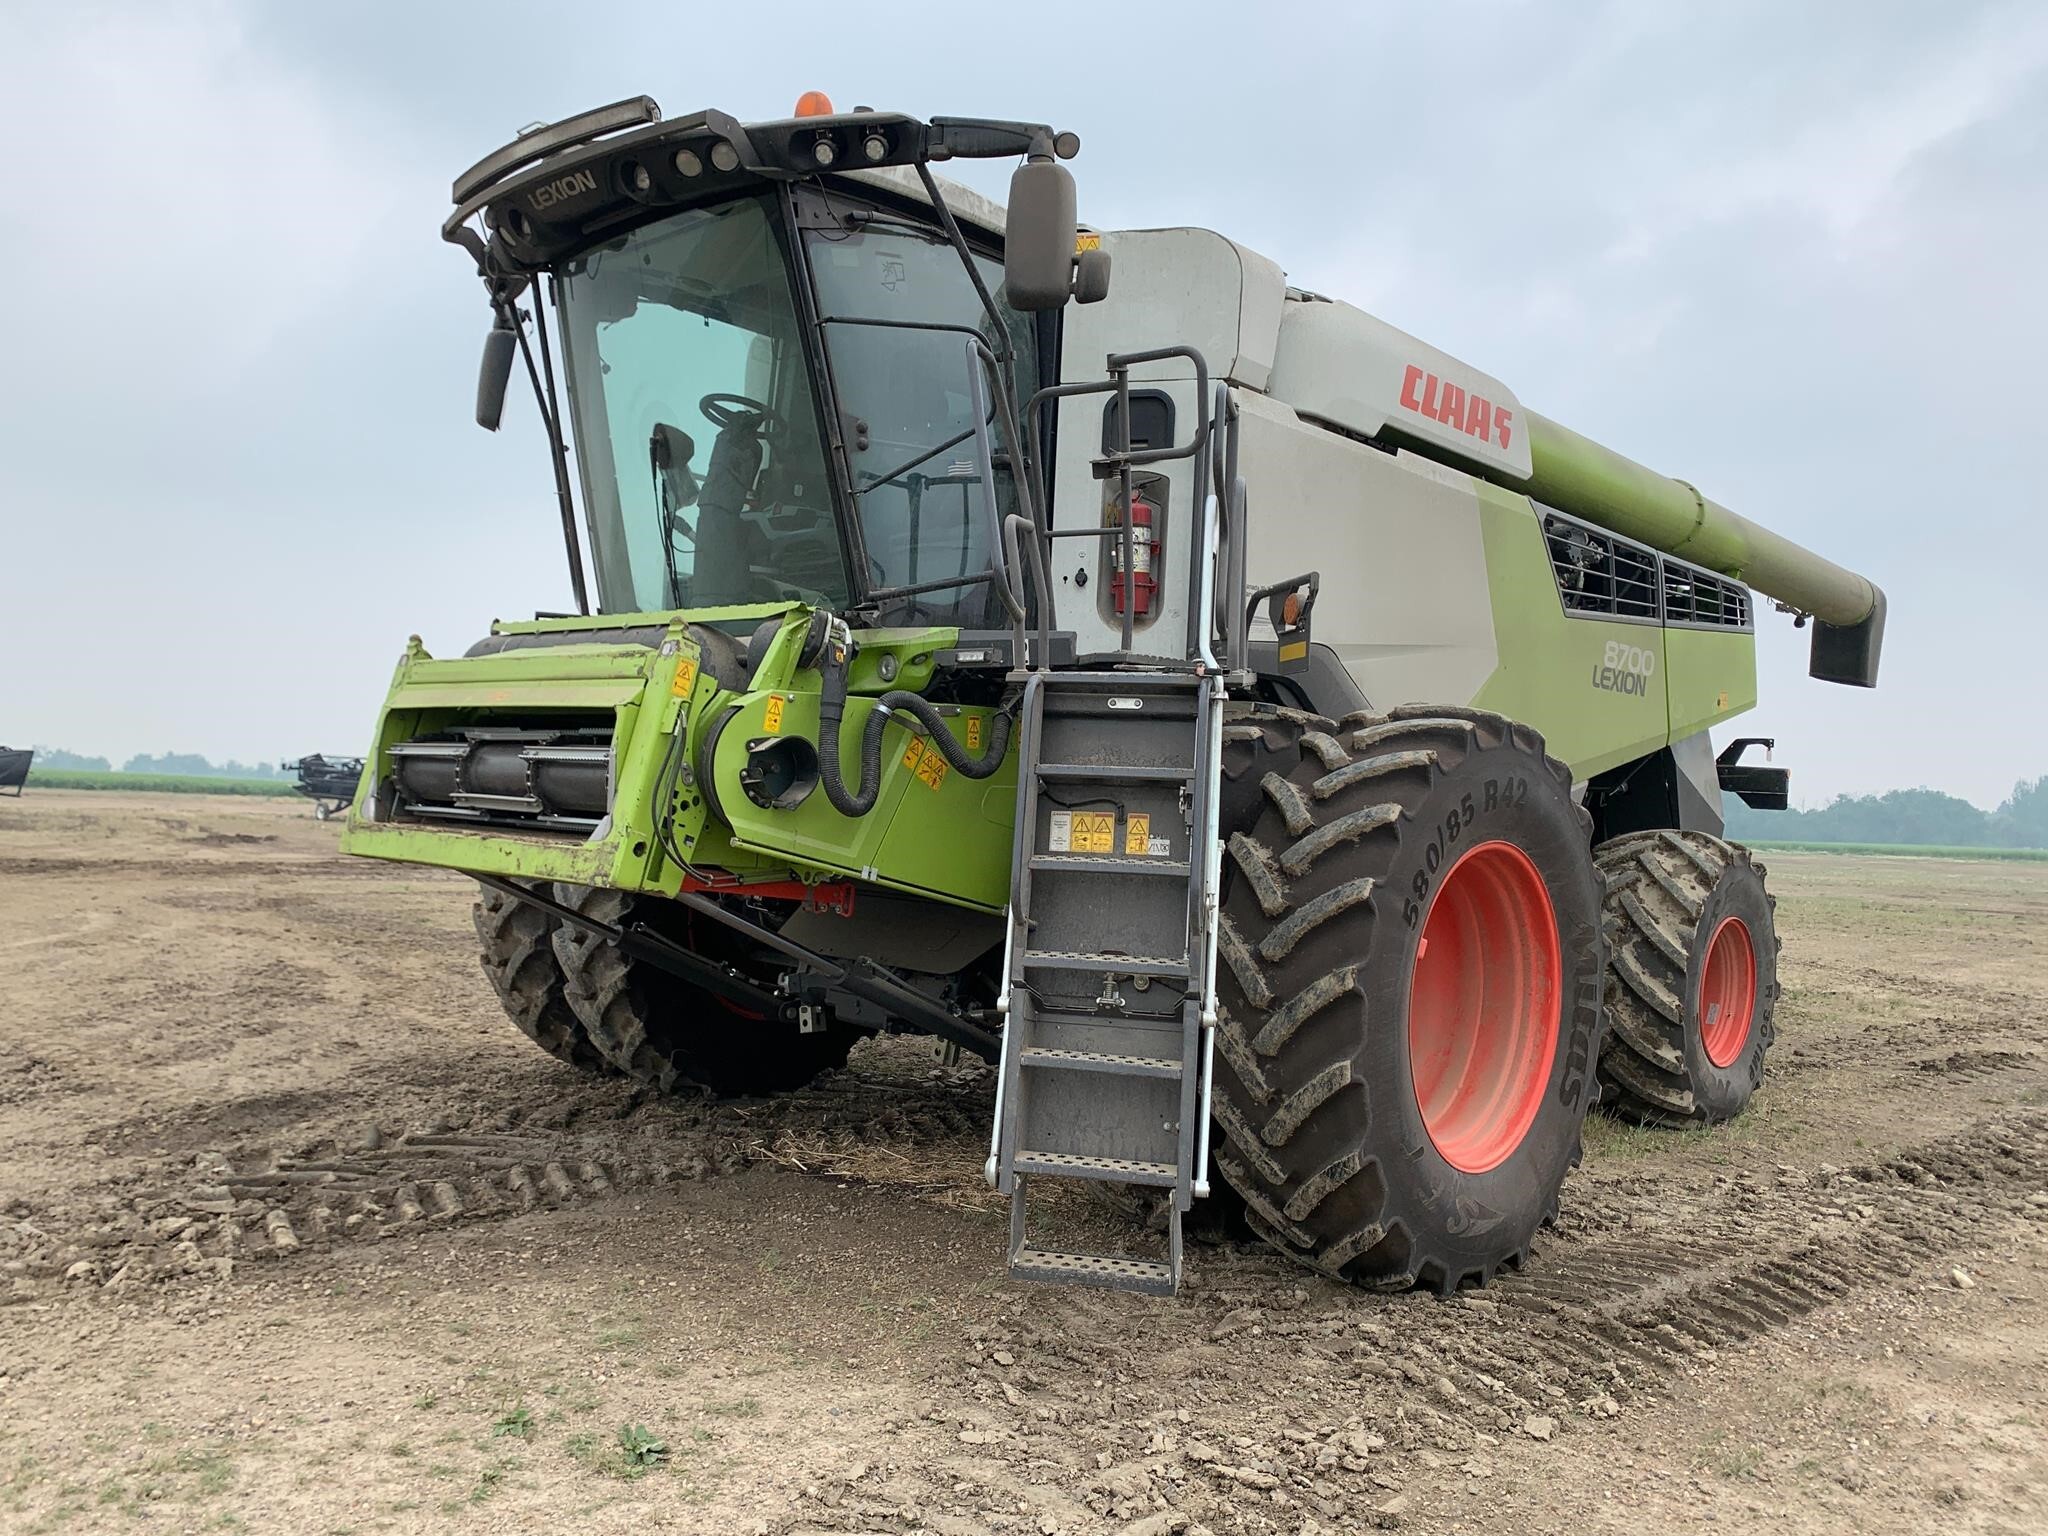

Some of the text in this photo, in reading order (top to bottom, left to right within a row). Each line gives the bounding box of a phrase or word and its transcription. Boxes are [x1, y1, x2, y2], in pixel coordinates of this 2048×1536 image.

[527, 169, 597, 211] LEXION
[1399, 364, 1513, 450] CLAAS
[1604, 640, 1655, 676] 8700
[1592, 665, 1648, 697] LEXION
[1402, 791, 1475, 931] 580/85
